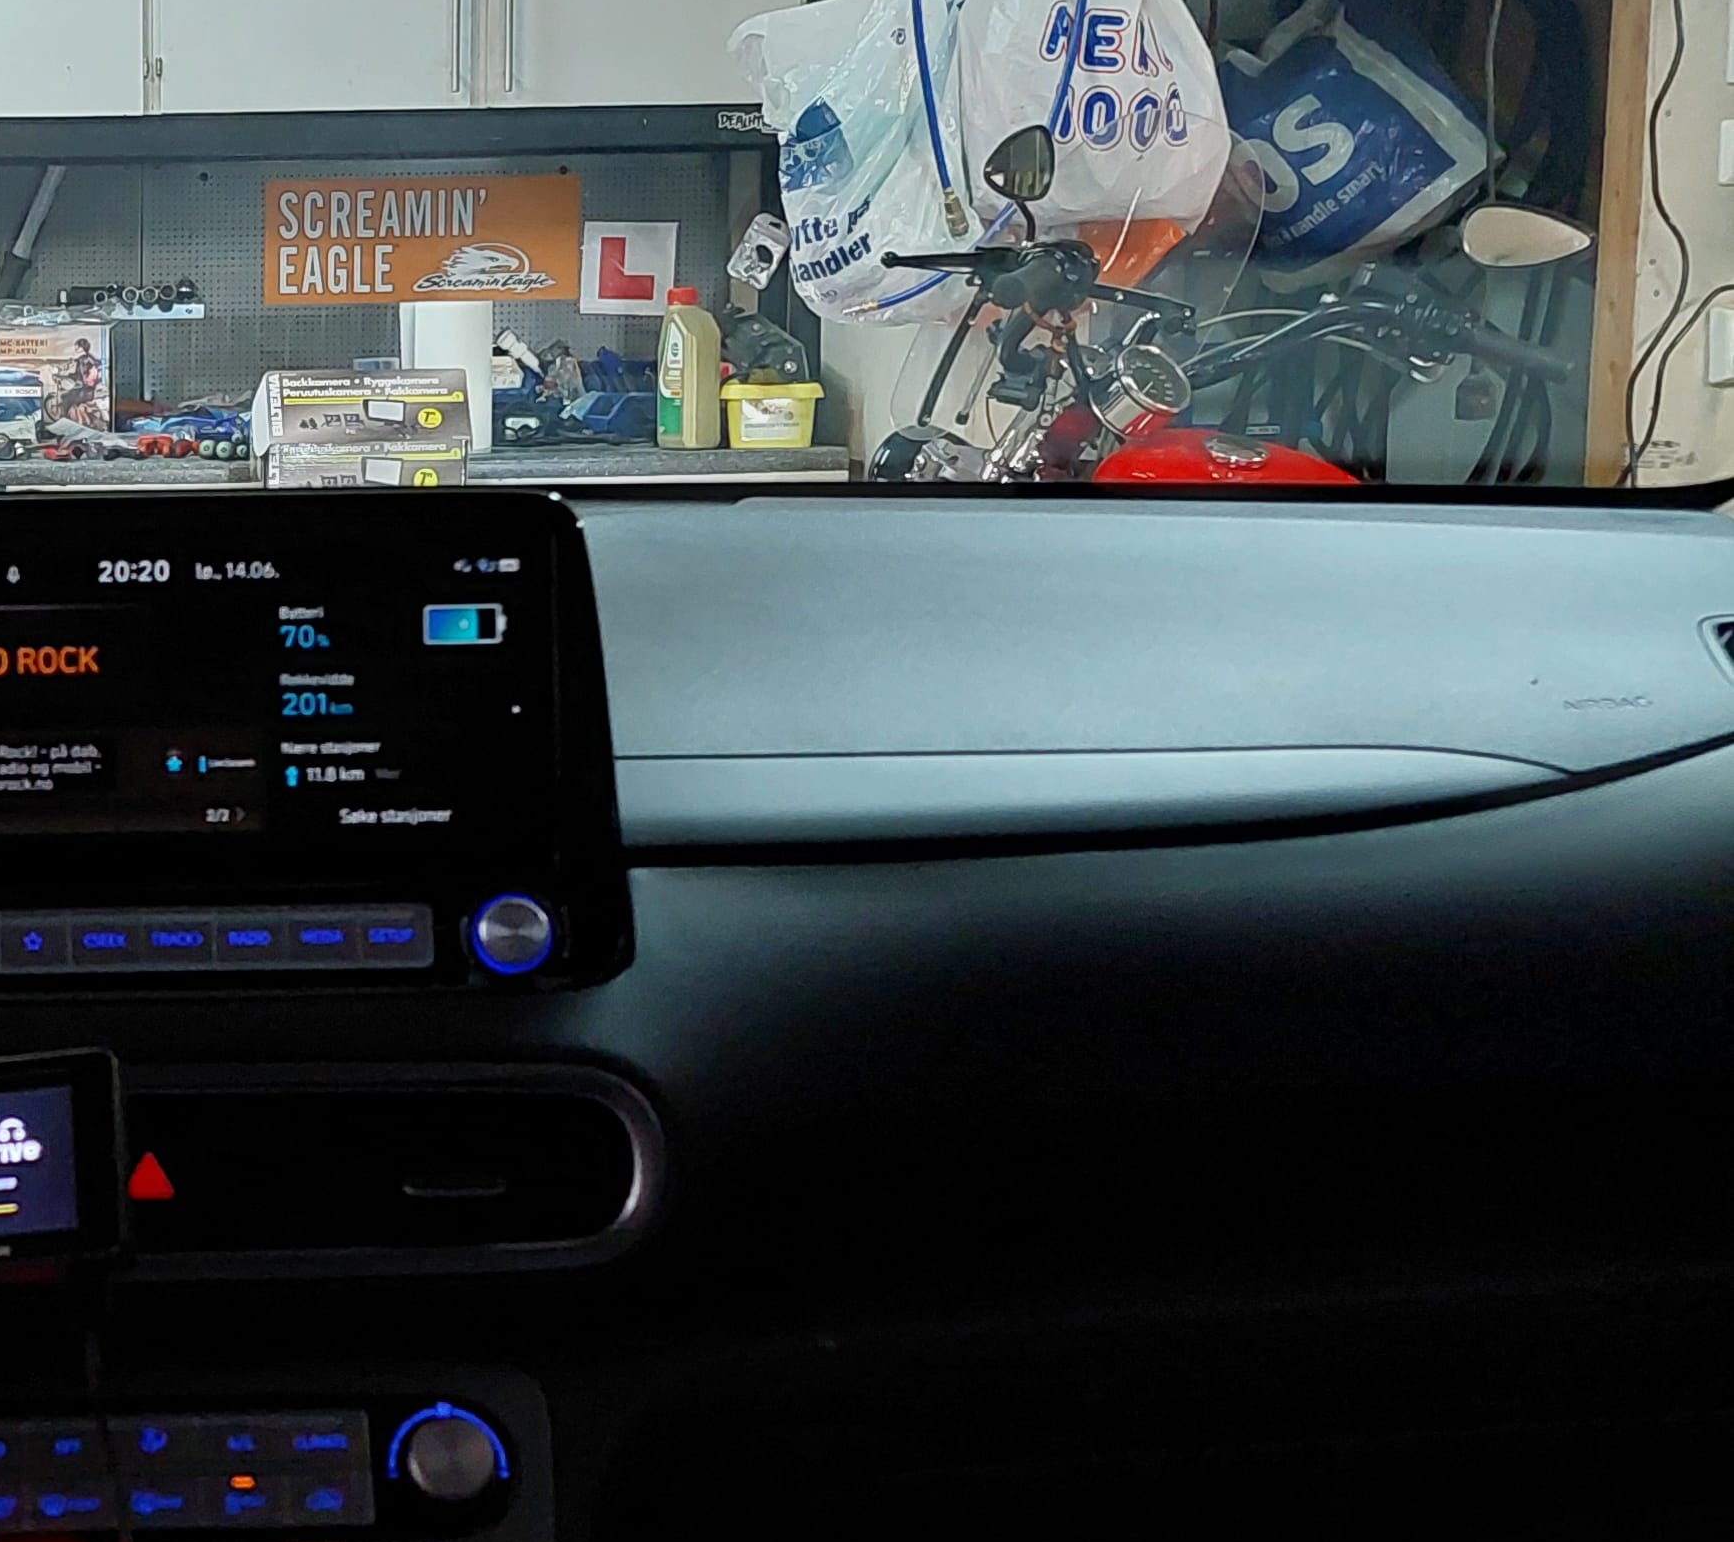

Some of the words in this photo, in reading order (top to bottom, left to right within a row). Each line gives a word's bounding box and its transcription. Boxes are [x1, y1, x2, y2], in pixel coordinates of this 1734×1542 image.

[277, 188, 488, 240] SCREAMIN'
[278, 243, 395, 295] EAGLE
[598, 236, 655, 300] L
[268, 373, 284, 437] BILTEMA
[98, 560, 171, 583] 20:20
[17, 645, 100, 674] ROCK
[281, 692, 327, 716] 201
